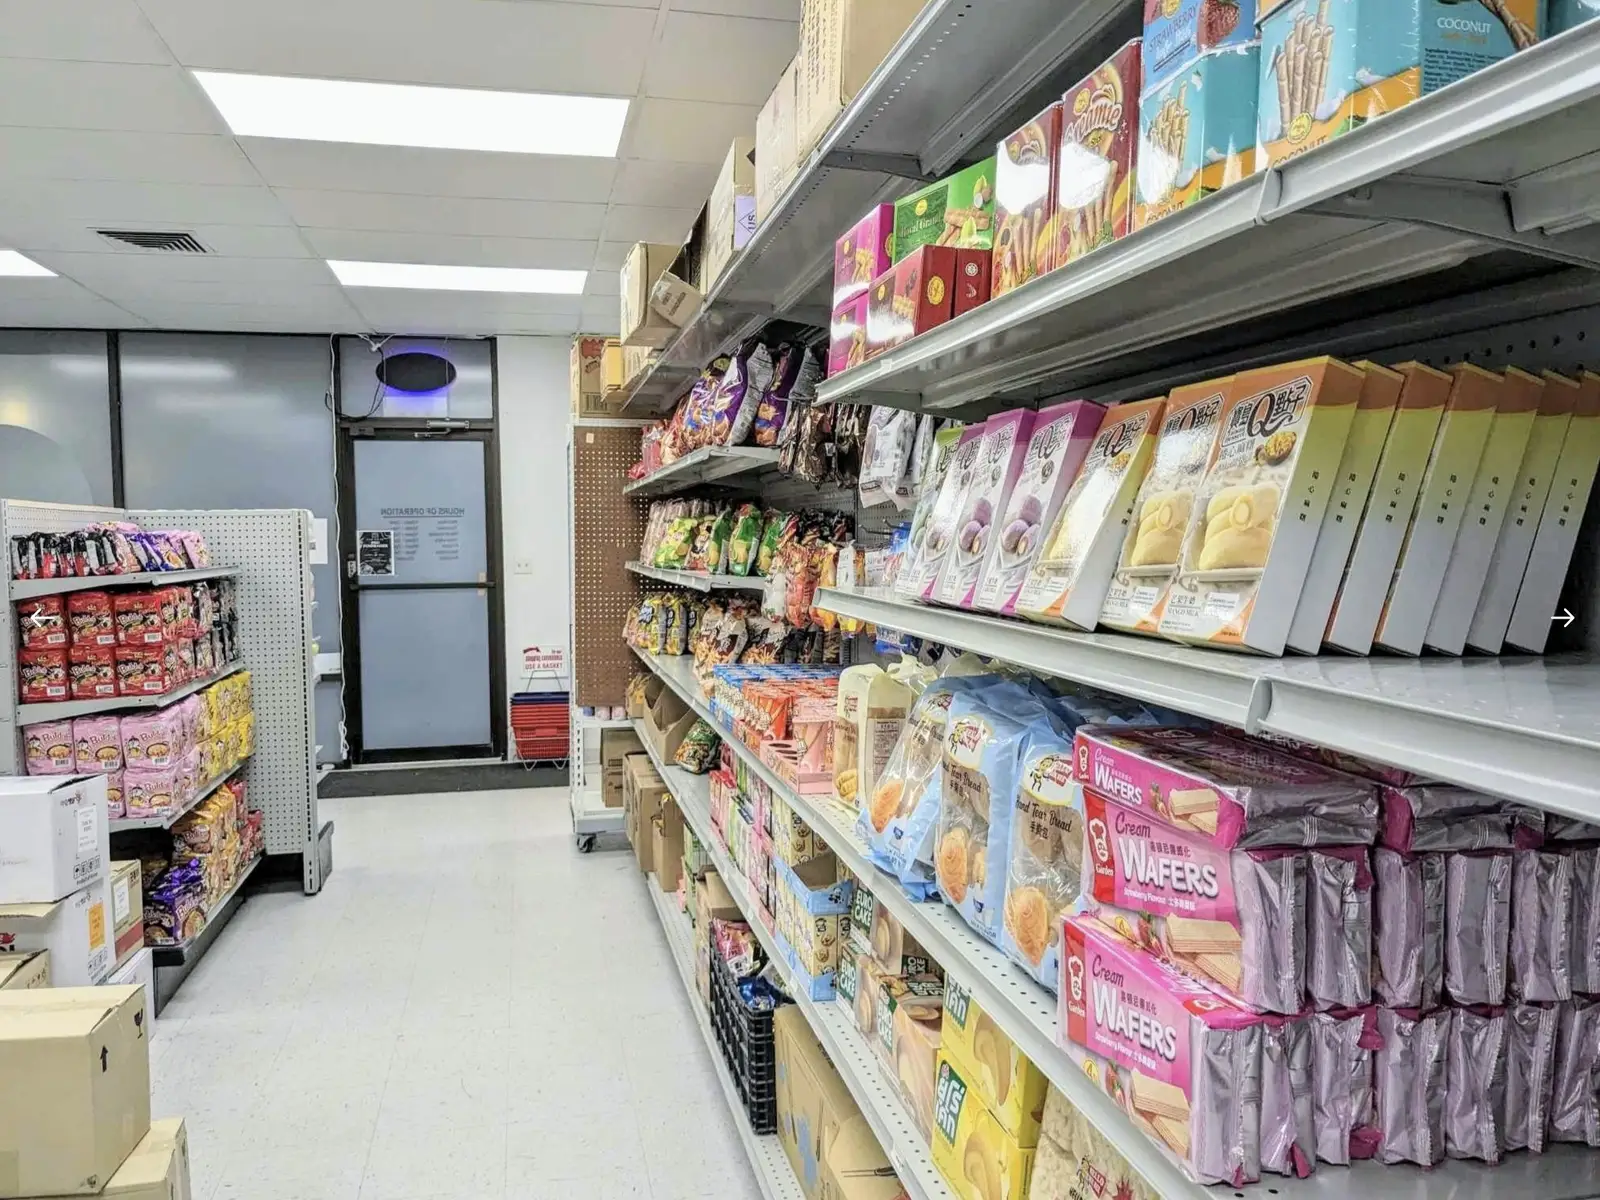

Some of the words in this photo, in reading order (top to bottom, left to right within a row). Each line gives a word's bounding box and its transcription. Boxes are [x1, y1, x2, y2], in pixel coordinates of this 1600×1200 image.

[1436, 17, 1491, 33] COCONUT
[1095, 748, 1115, 767] Cream
[1095, 761, 1142, 805] WAFERS
[1032, 802, 1047, 819] Tear
[1049, 810, 1072, 833] Bread
[1115, 811, 1151, 838] Cream
[1095, 862, 1114, 877] Garden
[1118, 836, 1219, 899] WAFERS
[856, 888, 873, 909] EURO
[854, 905, 873, 927] CAKE
[840, 959, 856, 980] EURO
[1092, 954, 1124, 988] Cream
[839, 976, 856, 999] CAKE
[1068, 1000, 1086, 1018] Garden
[1092, 979, 1178, 1062] WAFERS
